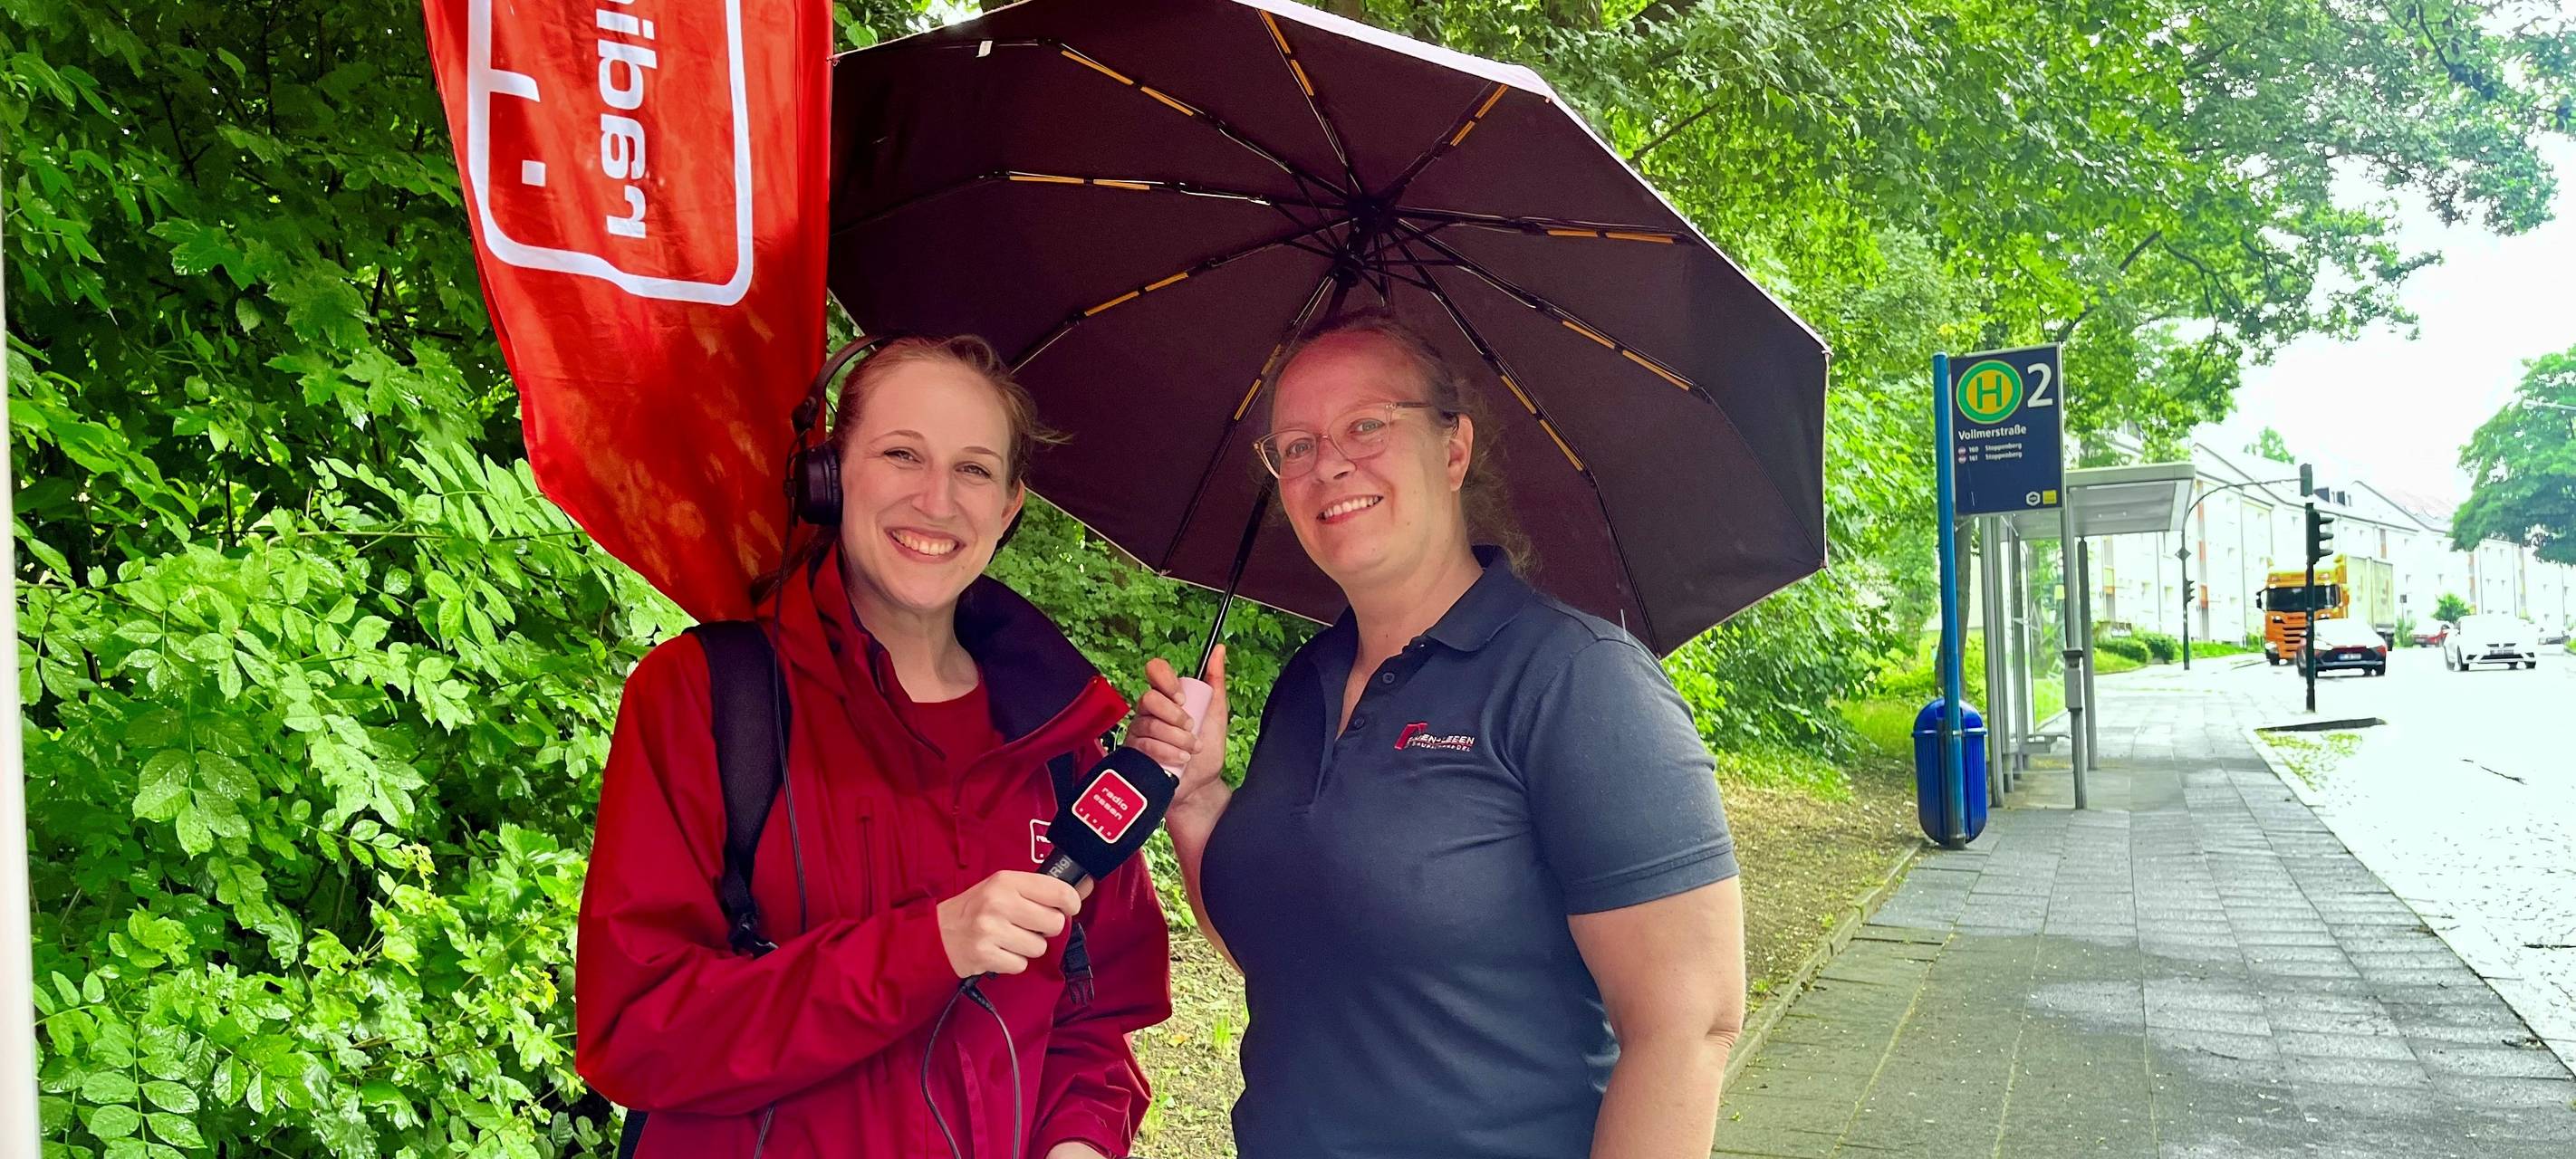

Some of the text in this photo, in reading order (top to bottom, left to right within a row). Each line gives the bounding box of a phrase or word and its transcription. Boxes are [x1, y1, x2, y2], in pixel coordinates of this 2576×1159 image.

[1976, 362, 2053, 409] H 2
[1958, 424, 2027, 441] Vollmerstraße
[1093, 793, 1123, 821] essen
[1101, 787, 1129, 811] radio
